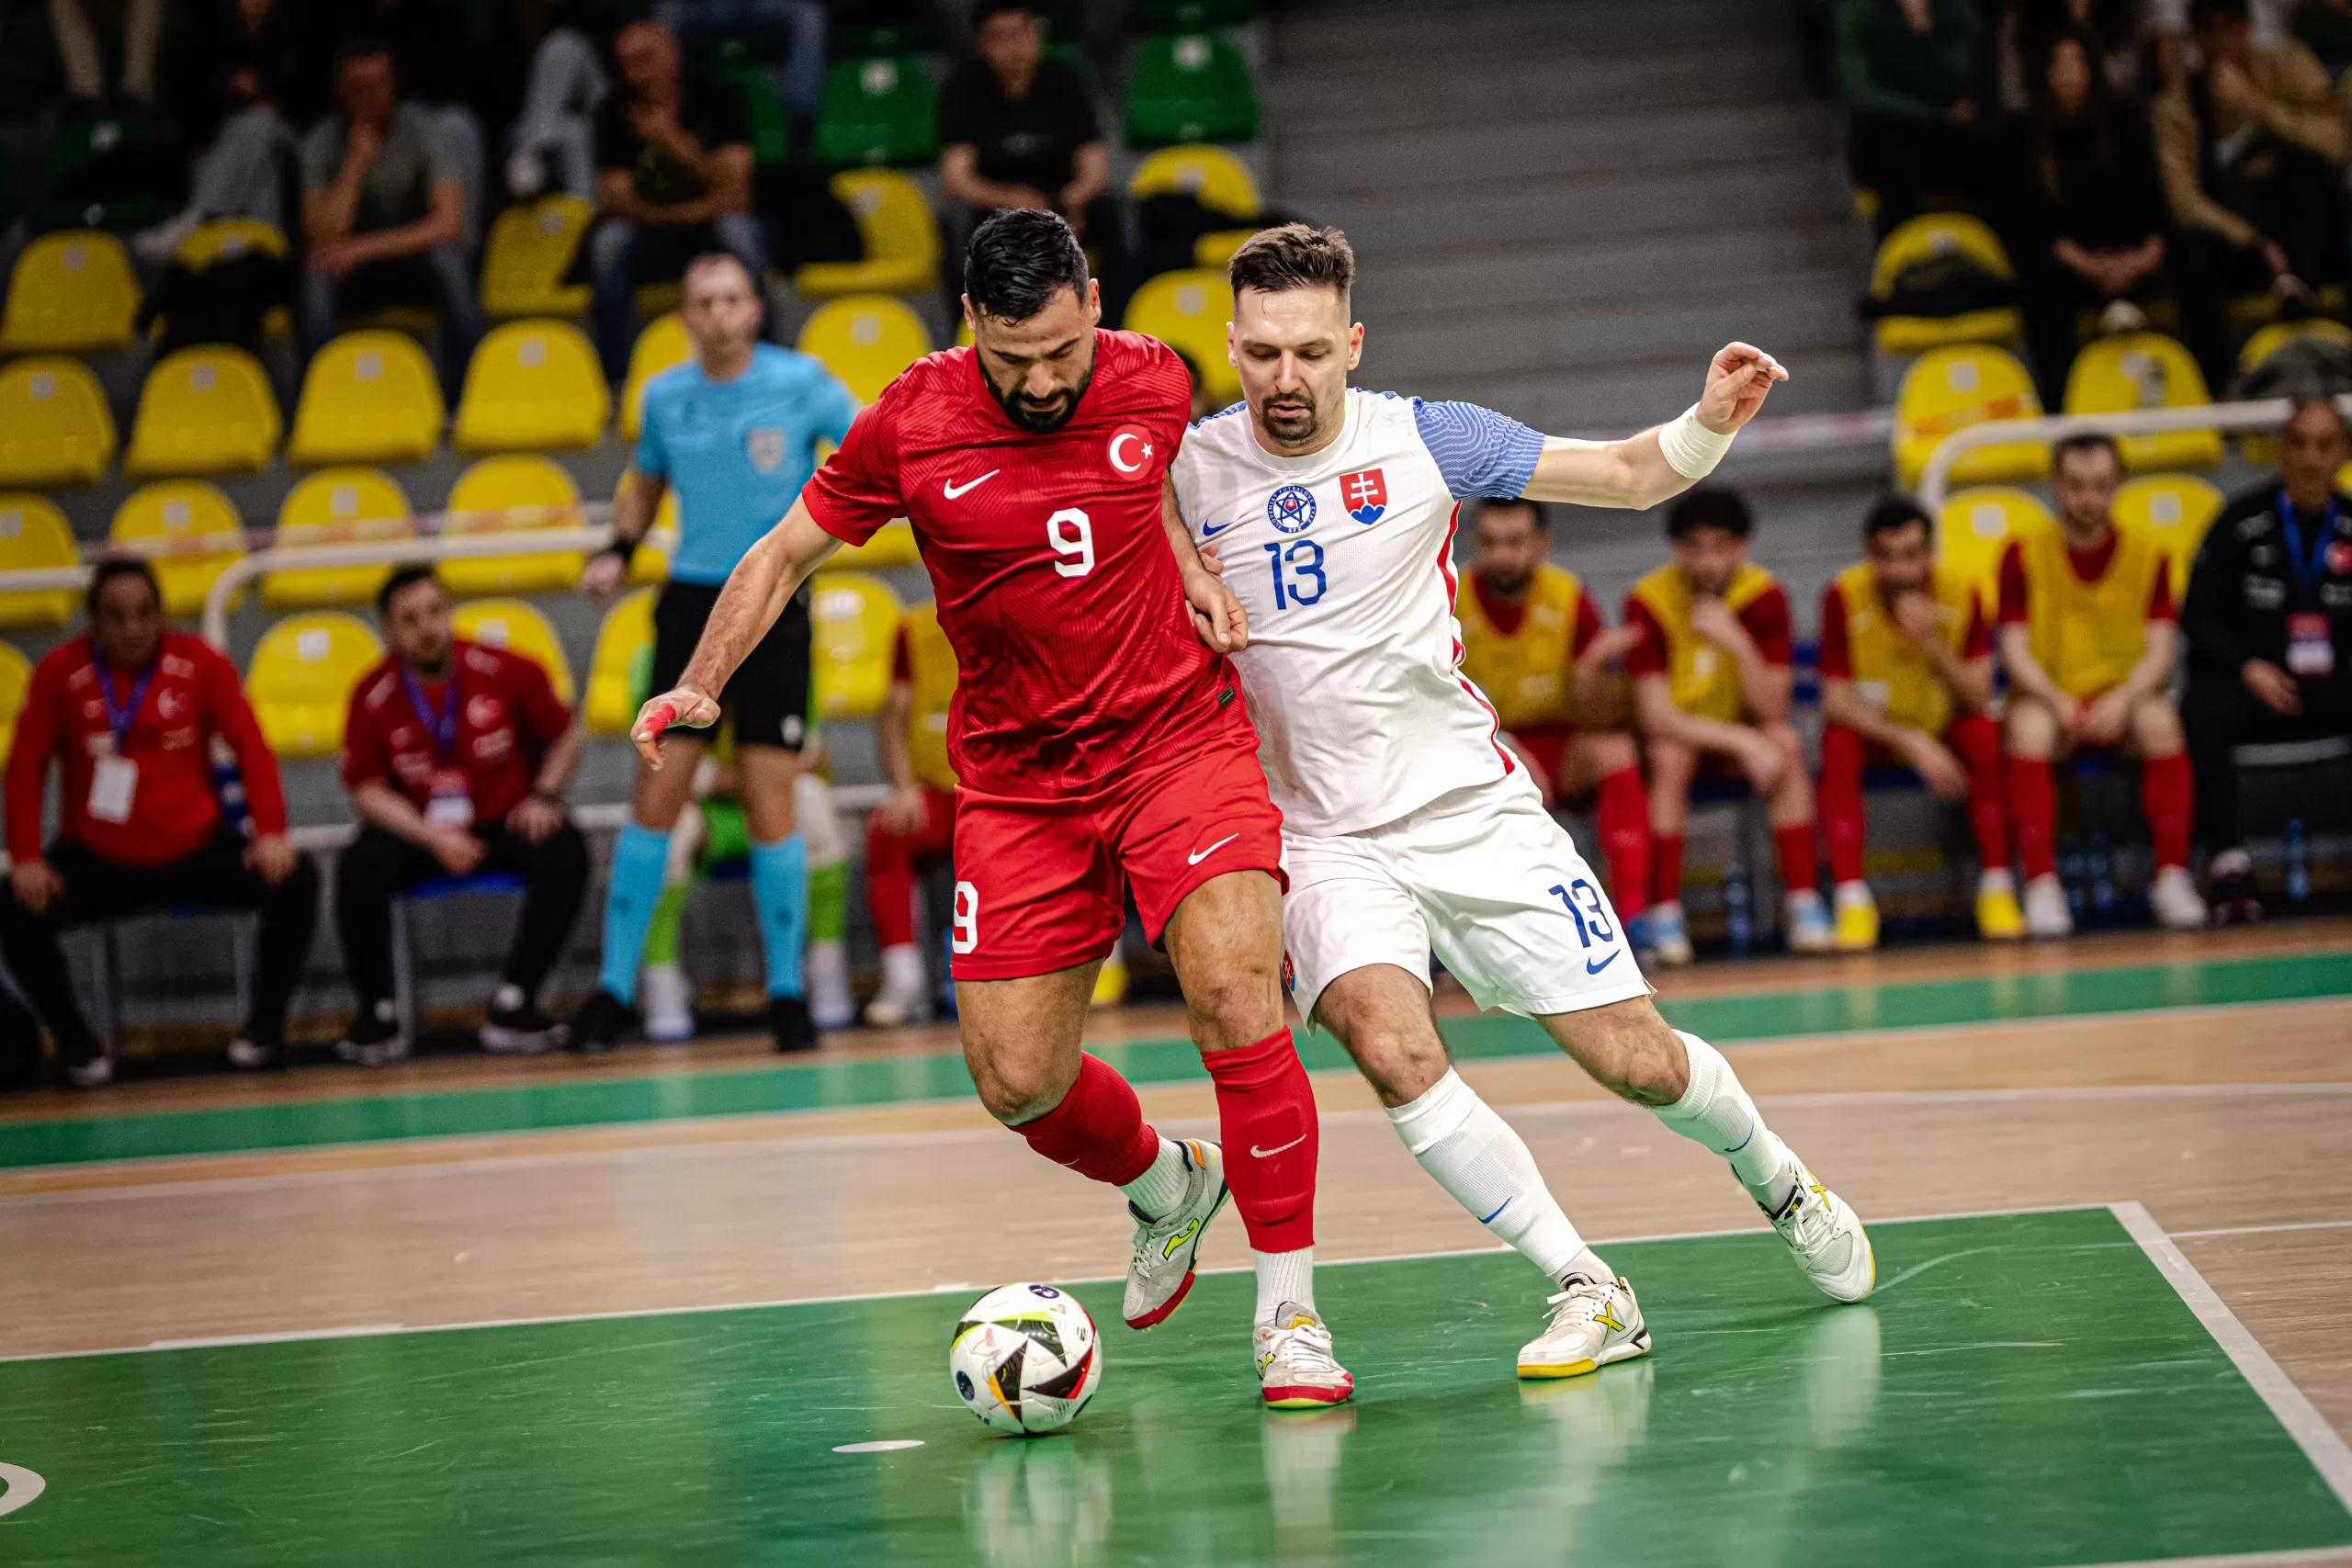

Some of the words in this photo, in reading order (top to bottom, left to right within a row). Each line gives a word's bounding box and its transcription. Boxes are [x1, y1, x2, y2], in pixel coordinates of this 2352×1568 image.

[1046, 507, 1095, 578] 9
[1264, 539, 1327, 610] 13
[952, 881, 978, 954] 9
[1548, 878, 1613, 948] 13
